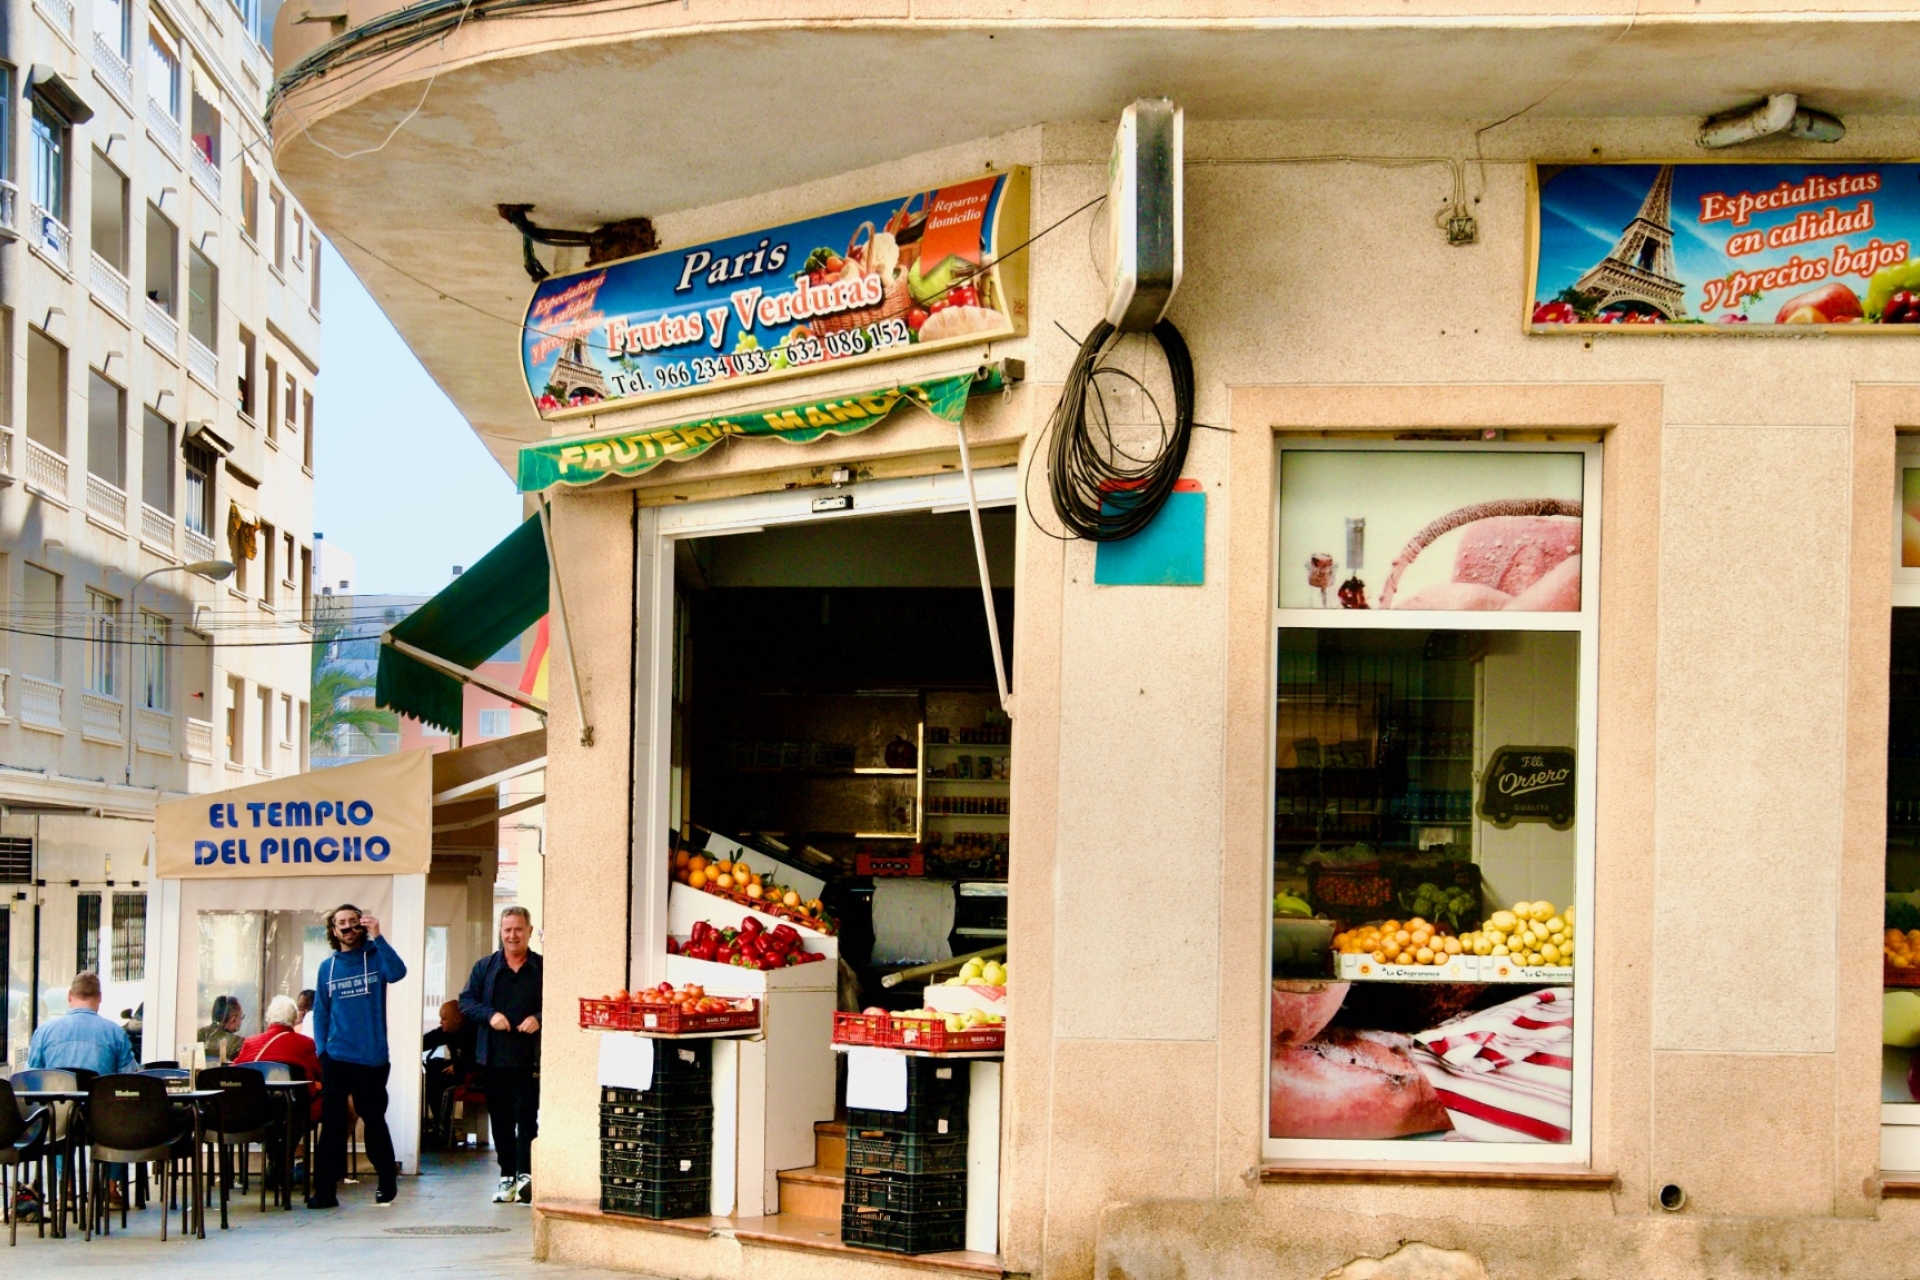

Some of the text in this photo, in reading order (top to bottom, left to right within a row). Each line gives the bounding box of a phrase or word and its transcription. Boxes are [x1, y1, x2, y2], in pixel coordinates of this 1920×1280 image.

[928, 209, 981, 229] domicilio
[934, 195, 978, 213] Reparto
[1703, 174, 1878, 223] Especialistas
[1728, 205, 1871, 256] en calidad
[676, 240, 787, 290] Paris
[1704, 243, 1906, 310] y precios bajos
[534, 275, 606, 316] Especialistas
[541, 296, 595, 331] en calidad
[605, 276, 881, 356] Frutas y Verduras
[532, 346, 542, 364] y
[574, 311, 604, 336] bajos
[612, 321, 907, 395] Tel. 966 234 033 632 086 152
[1498, 768, 1570, 794] Orsero
[209, 800, 374, 829] EL TEMPLO
[194, 835, 391, 866] DEL PINCHO
